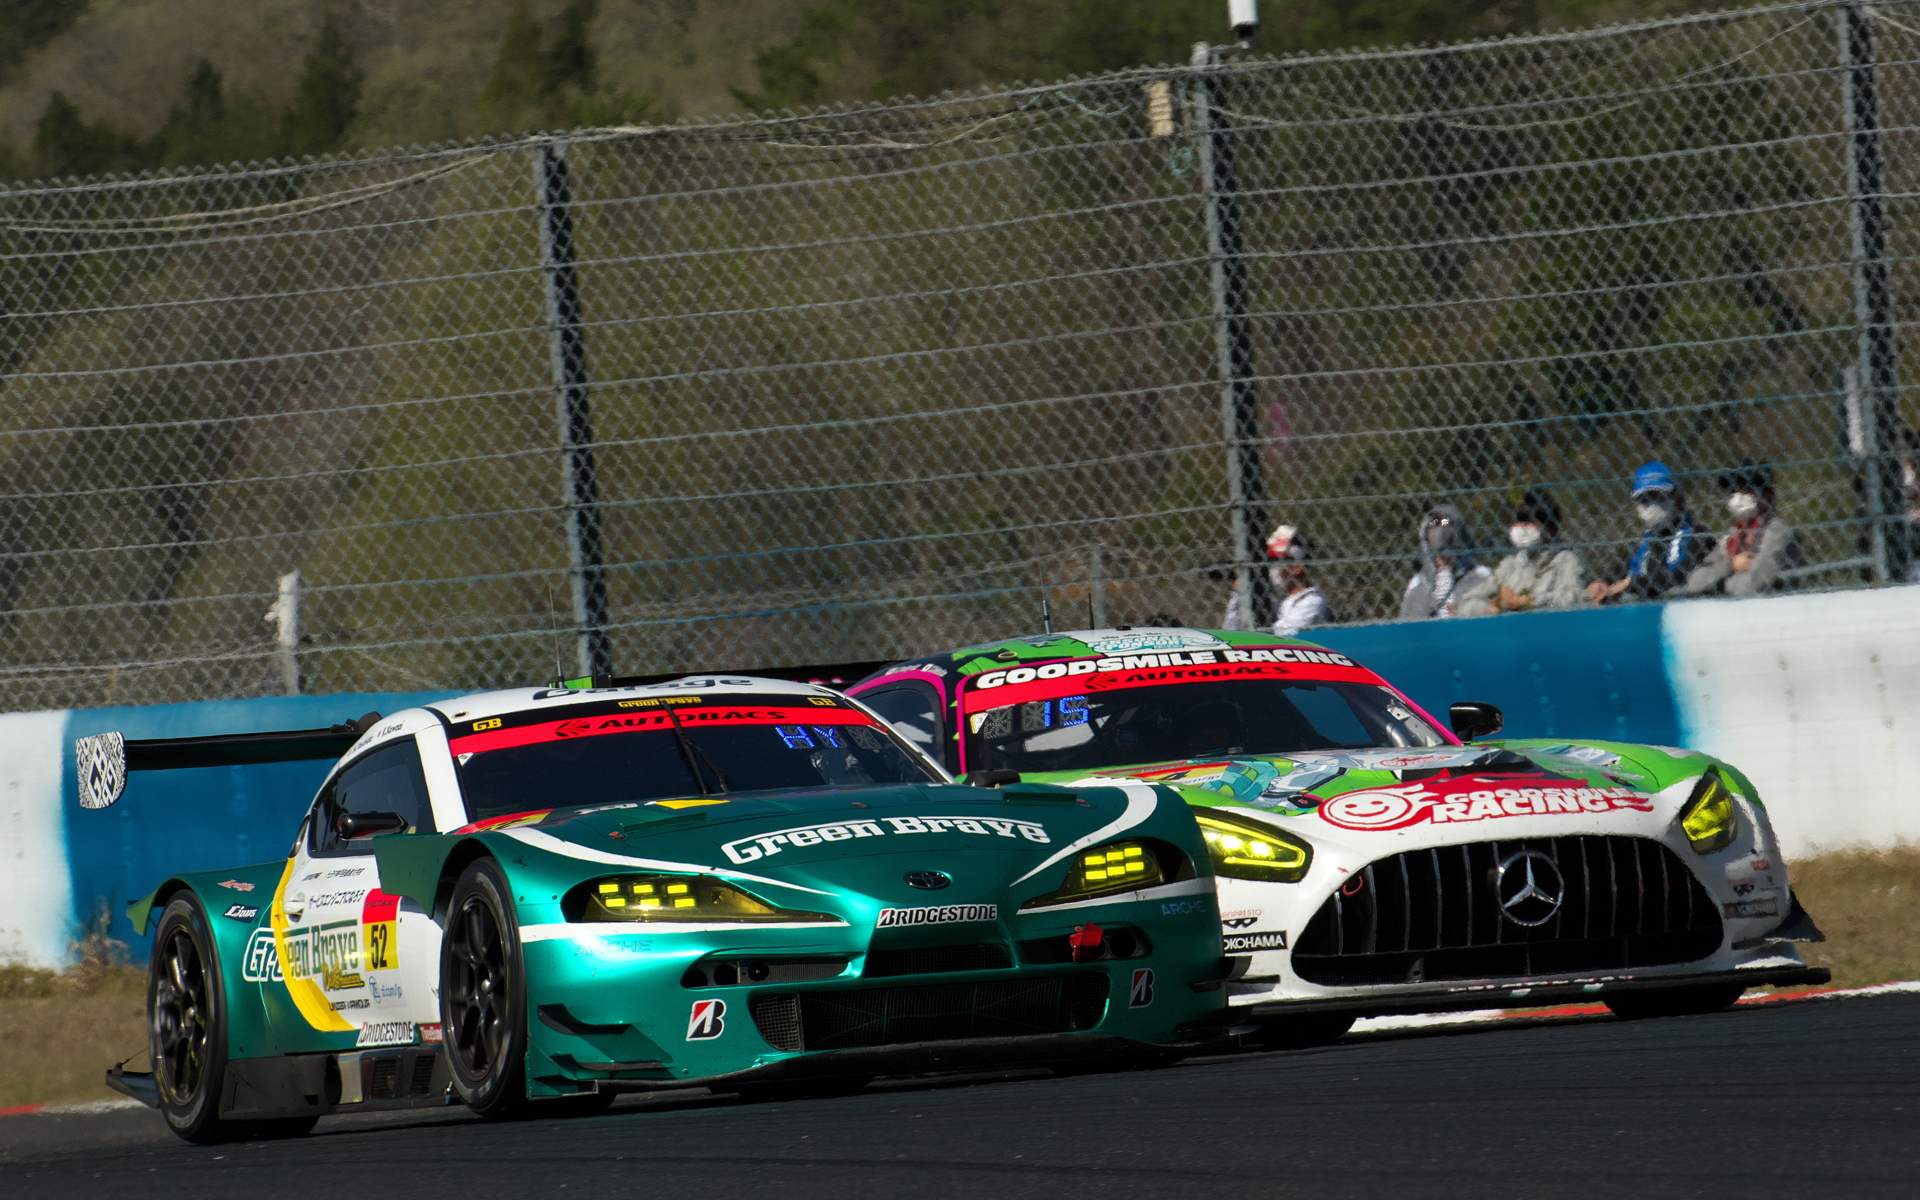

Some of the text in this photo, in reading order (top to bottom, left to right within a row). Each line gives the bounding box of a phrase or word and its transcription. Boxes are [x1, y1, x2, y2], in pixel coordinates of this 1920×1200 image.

[976, 651, 1217, 689] GOODSMILE
[1225, 649, 1353, 667] RACING
[1124, 665, 1292, 683] AUTOBACS
[473, 718, 502, 731] GB
[596, 711, 787, 729] AUTOBACS
[775, 725, 840, 749] HY
[1444, 786, 1633, 804] GOODSMILE
[1432, 796, 1604, 823] RACING
[721, 815, 1051, 864] Green Brave
[370, 898, 397, 908] AUTOBACS
[1161, 900, 1206, 916] ARCHE
[1222, 908, 1262, 918] ANPRESTO
[879, 904, 997, 927] BRIDGESTONE
[311, 924, 359, 975] Brave
[371, 923, 388, 970] 52
[1223, 934, 1285, 951] OKOHAMA
[356, 1021, 413, 1046] BRIDGESTONE
